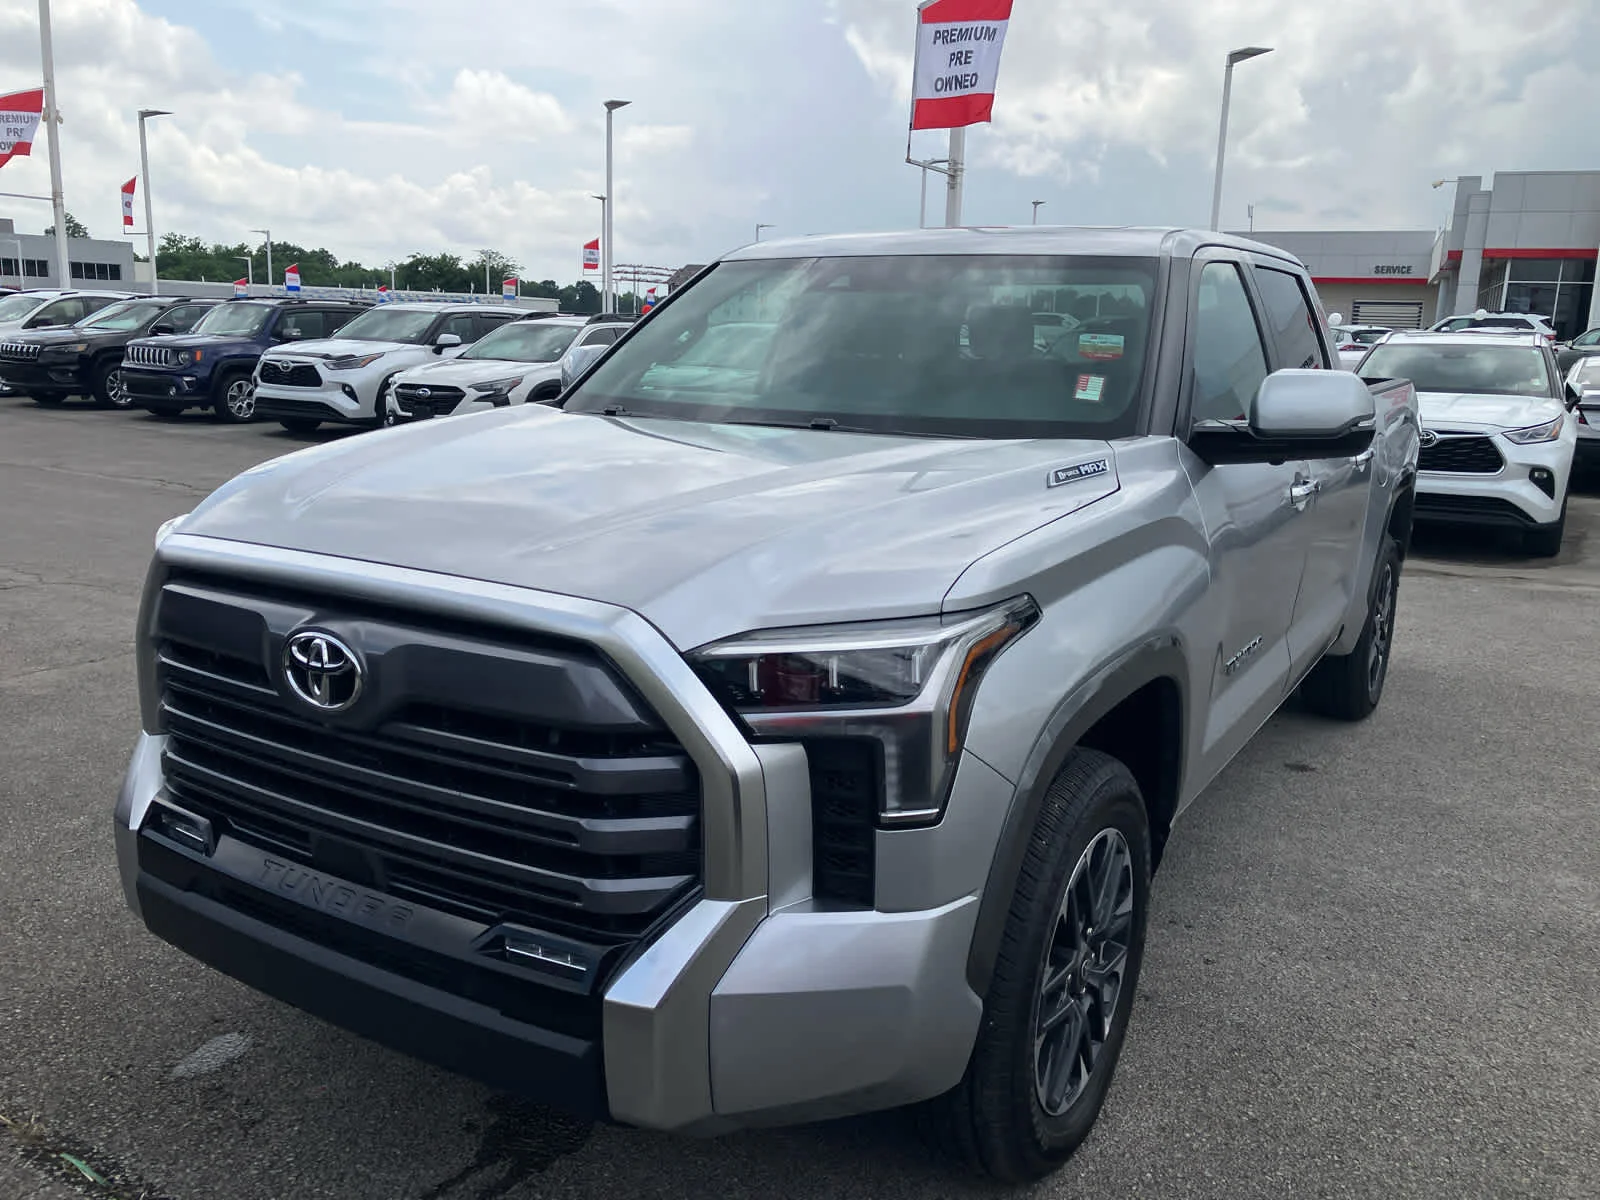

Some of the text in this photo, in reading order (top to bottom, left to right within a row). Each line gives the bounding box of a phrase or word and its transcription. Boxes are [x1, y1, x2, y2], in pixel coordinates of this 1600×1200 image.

[933, 26, 998, 45] PREMIUM
[949, 50, 974, 67] PRE
[934, 72, 978, 92] OWNED
[0, 114, 38, 124] REMIU
[1374, 265, 1413, 274] SERVICE
[1080, 460, 1106, 475] MAX
